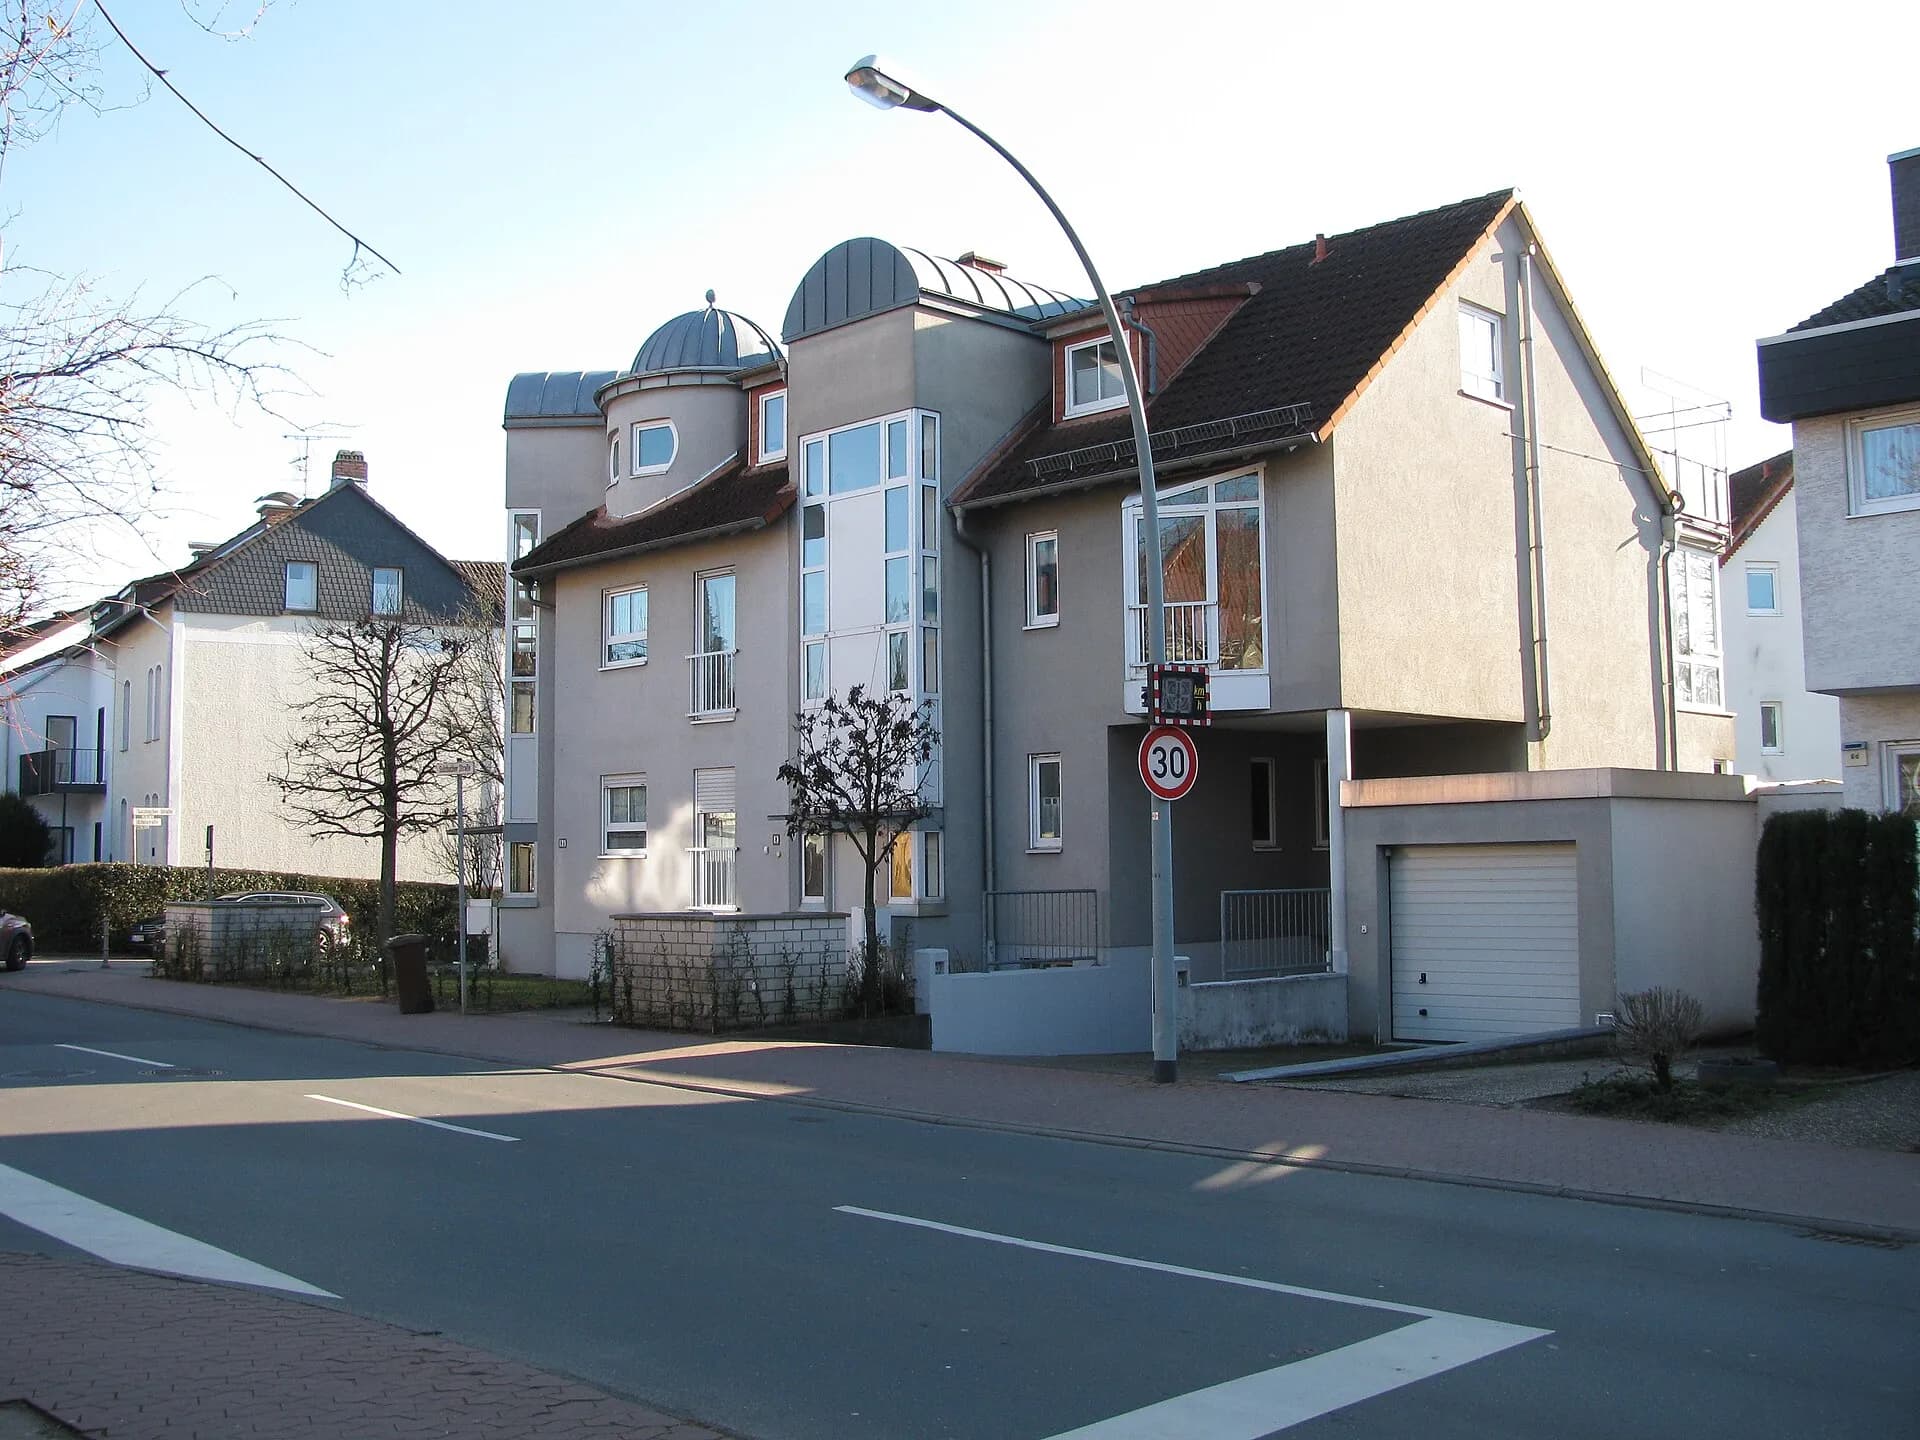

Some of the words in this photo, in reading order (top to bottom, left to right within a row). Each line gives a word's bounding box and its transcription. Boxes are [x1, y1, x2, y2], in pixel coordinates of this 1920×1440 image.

[1194, 684, 1205, 696] km
[1197, 699, 1202, 711] h
[1152, 746, 1185, 779] 30
